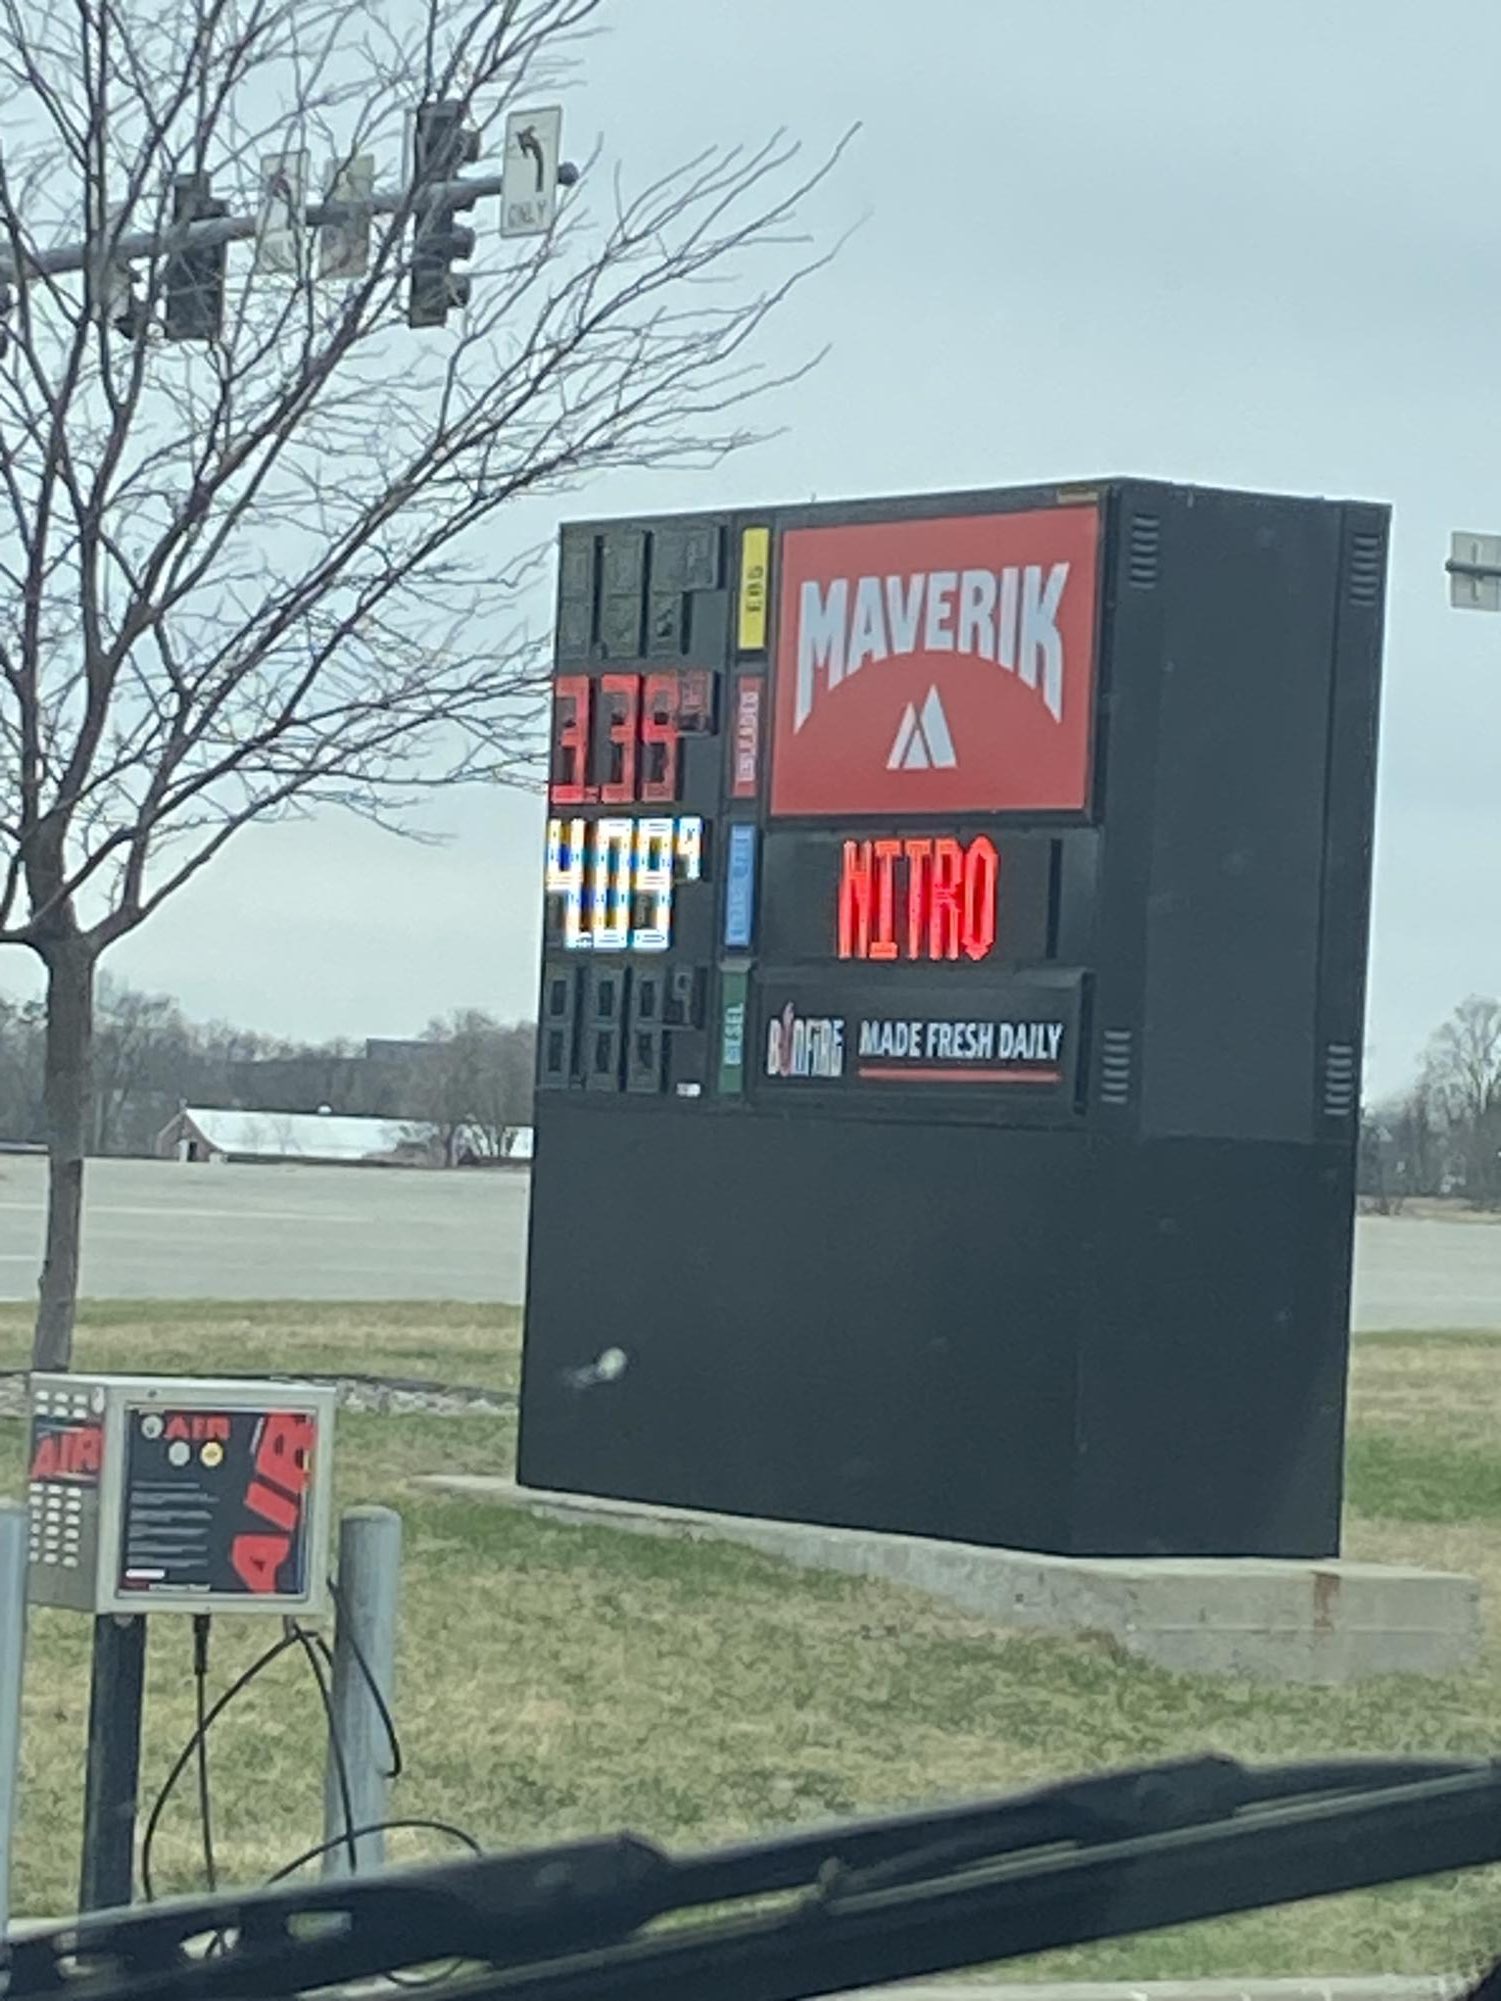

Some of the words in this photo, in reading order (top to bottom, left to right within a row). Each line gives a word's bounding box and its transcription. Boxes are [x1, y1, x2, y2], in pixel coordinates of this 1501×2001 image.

[793, 562, 1070, 735] MAVERIK
[838, 834, 998, 961] NITRO
[859, 1020, 922, 1057] MADE
[926, 1021, 993, 1059] FRESH
[998, 1022, 1063, 1060] DAILY
[32, 1426, 104, 1478] AIR
[164, 1414, 231, 1440] AIR
[232, 1410, 315, 1593] AIR
